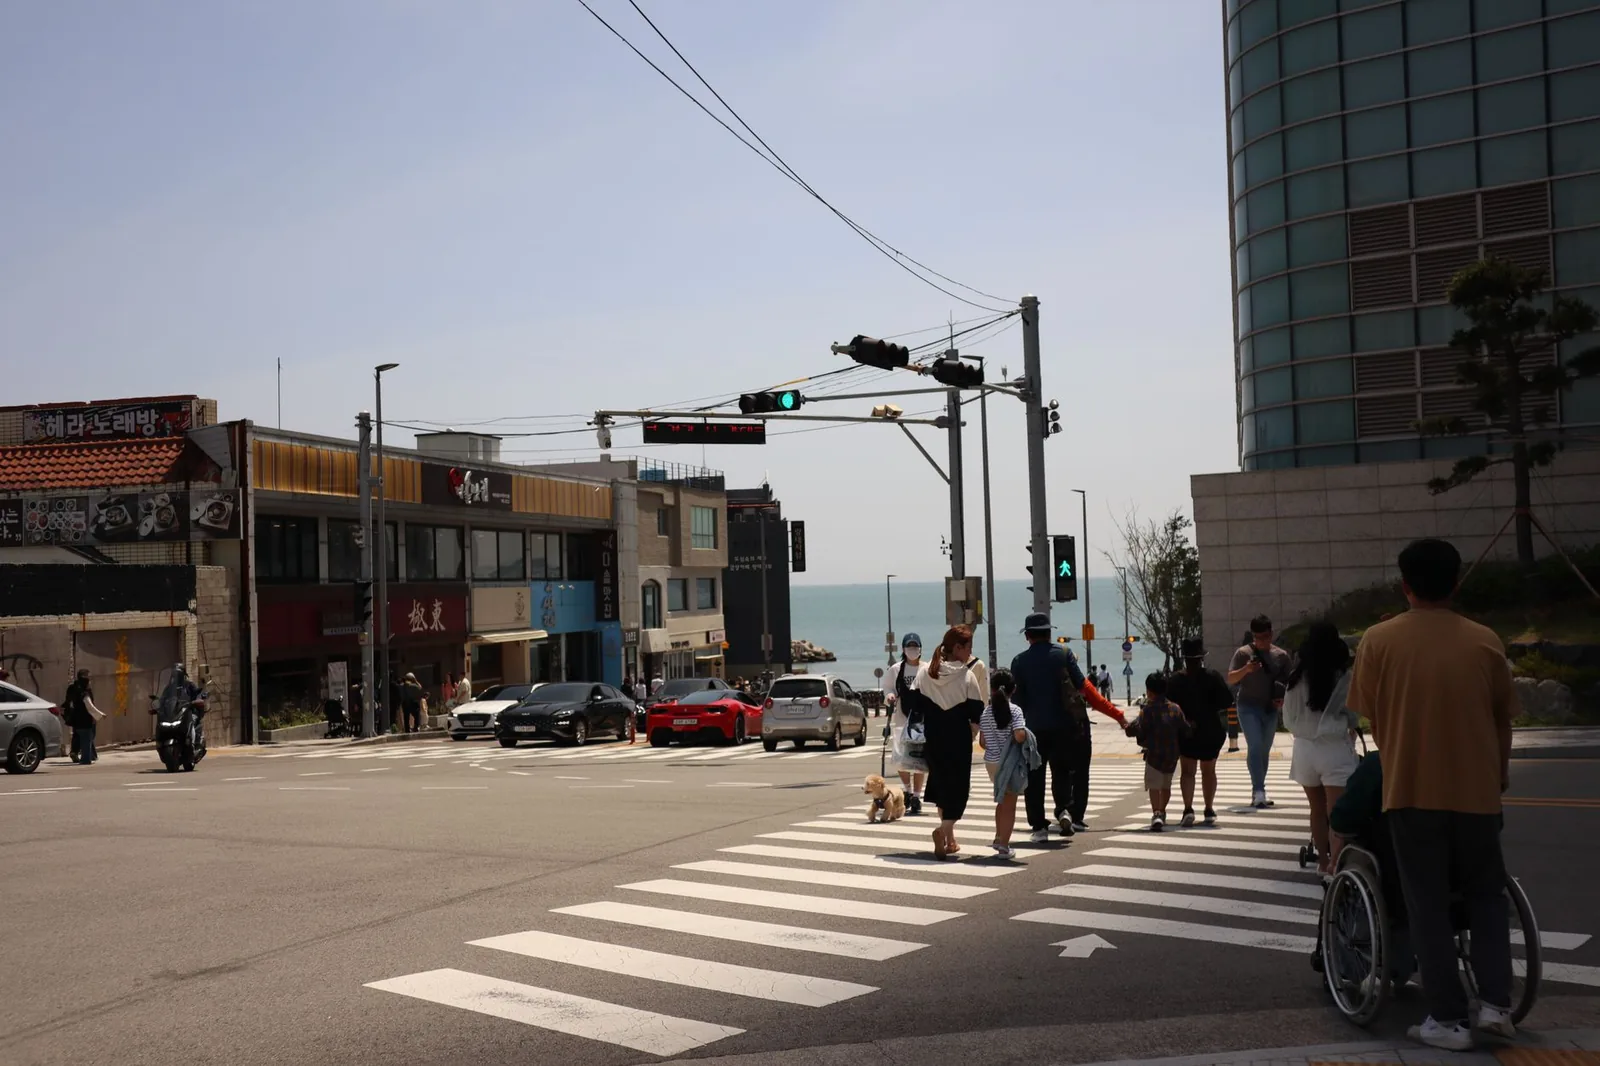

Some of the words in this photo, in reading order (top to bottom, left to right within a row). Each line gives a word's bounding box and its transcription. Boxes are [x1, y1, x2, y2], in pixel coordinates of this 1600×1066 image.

[45, 410, 85, 438] 헤라
[90, 408, 160, 436] 노래방
[407, 597, 446, 633] 極東
